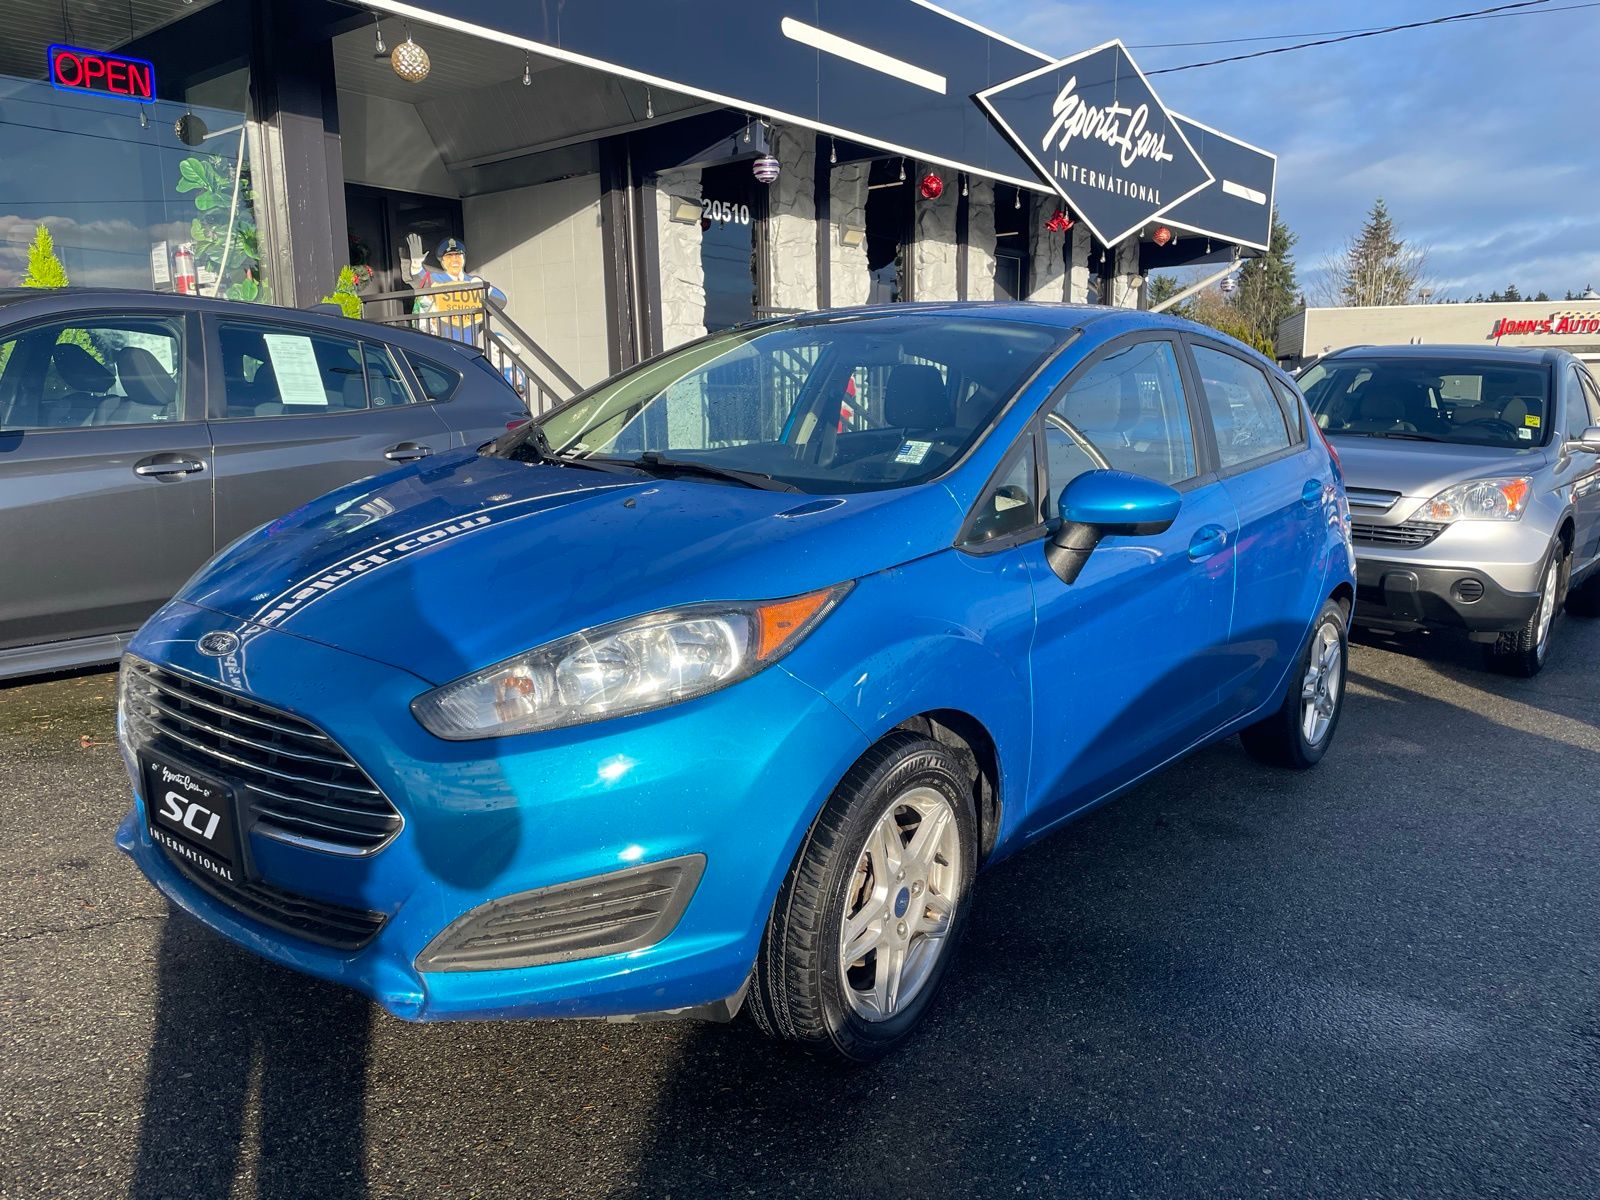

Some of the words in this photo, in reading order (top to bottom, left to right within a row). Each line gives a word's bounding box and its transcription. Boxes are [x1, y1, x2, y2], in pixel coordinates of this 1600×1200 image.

[54, 51, 151, 97] OPEN
[1042, 76, 1131, 152] Sports
[1117, 103, 1173, 168] Cars
[1054, 160, 1161, 205] INTERNATIONAL
[702, 198, 749, 225] 20510
[442, 289, 483, 303] SLOW
[159, 790, 221, 840] SCI
[149, 827, 234, 882] INTERNATIONAL
